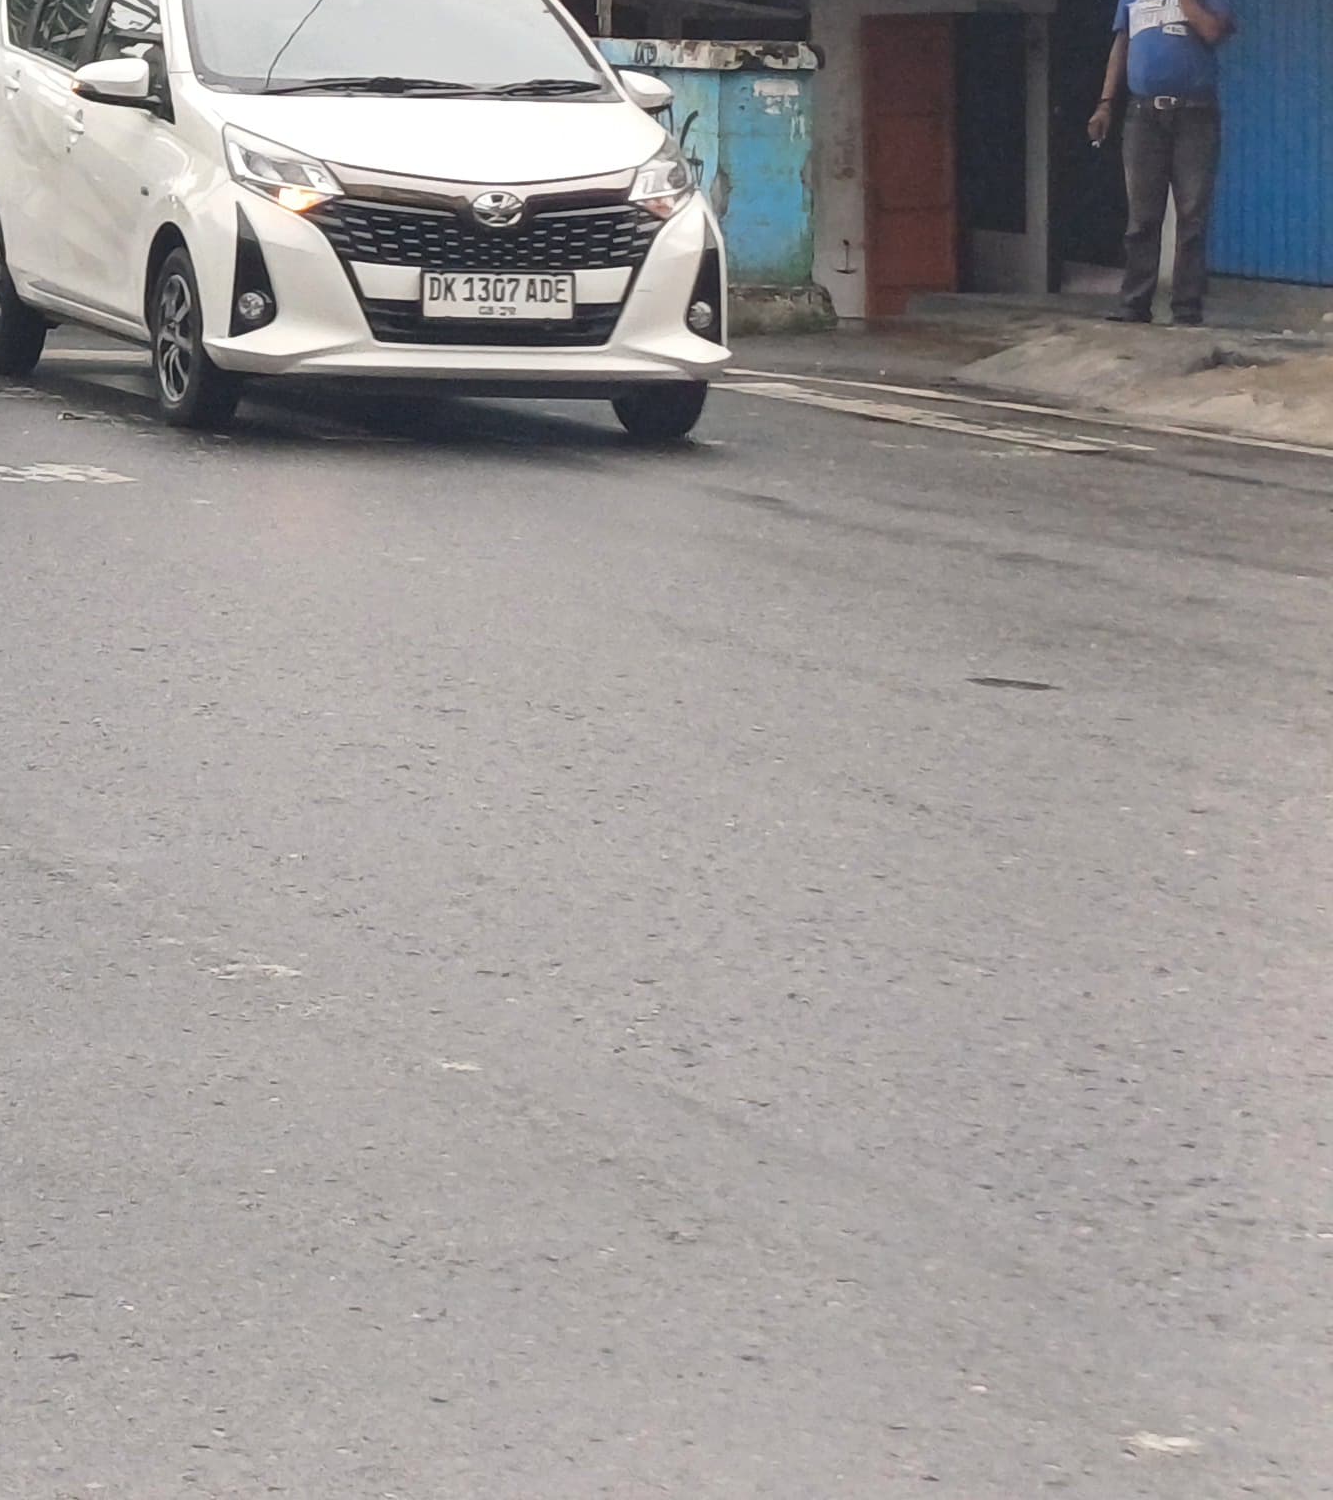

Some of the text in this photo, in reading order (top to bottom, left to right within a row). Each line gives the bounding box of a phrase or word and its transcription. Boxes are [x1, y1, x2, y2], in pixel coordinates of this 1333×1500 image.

[428, 277, 568, 303] DK 1307 ADE
